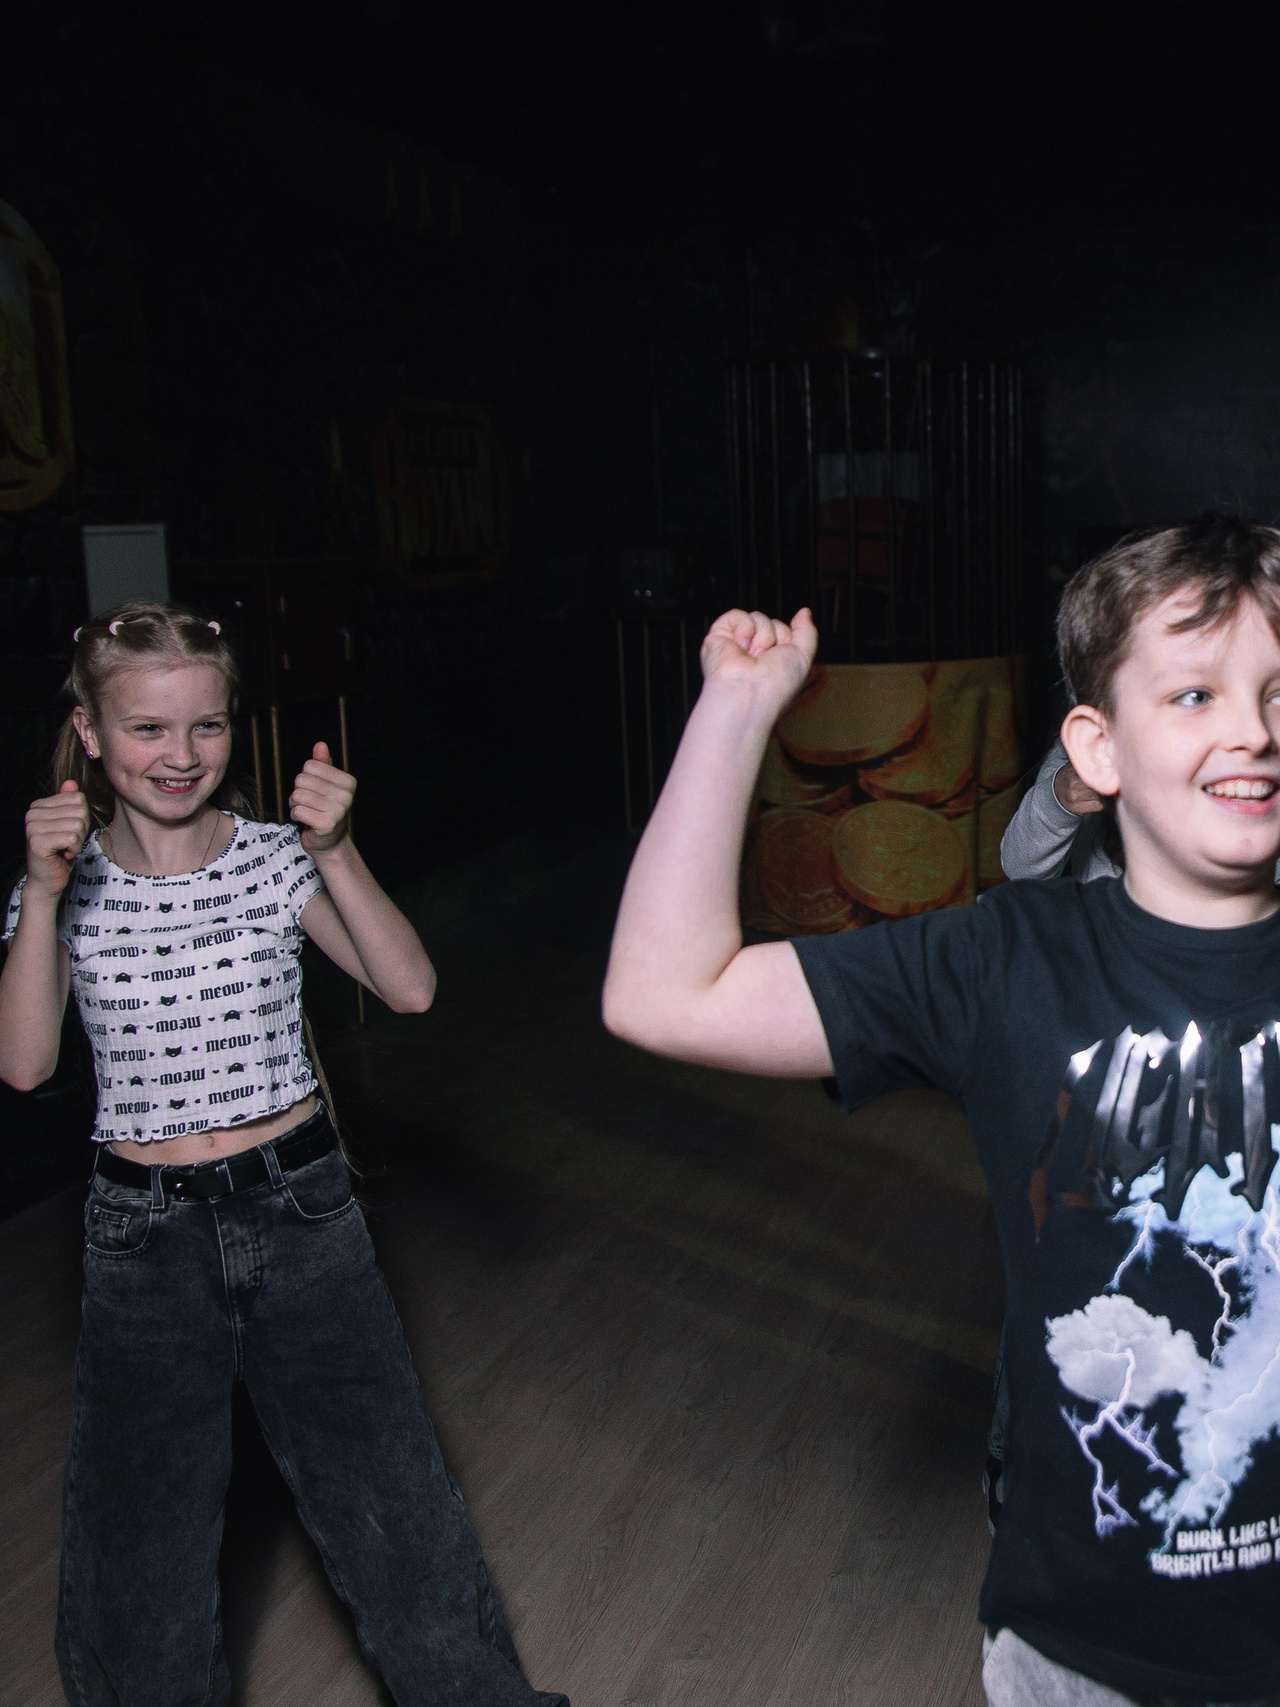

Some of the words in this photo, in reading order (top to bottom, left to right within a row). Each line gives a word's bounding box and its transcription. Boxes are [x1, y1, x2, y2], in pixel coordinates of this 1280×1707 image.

[1229, 1520, 1267, 1547] LIKE
[1150, 1548, 1236, 1579] BRIGHTLY
[1238, 1542, 1272, 1569] AND
